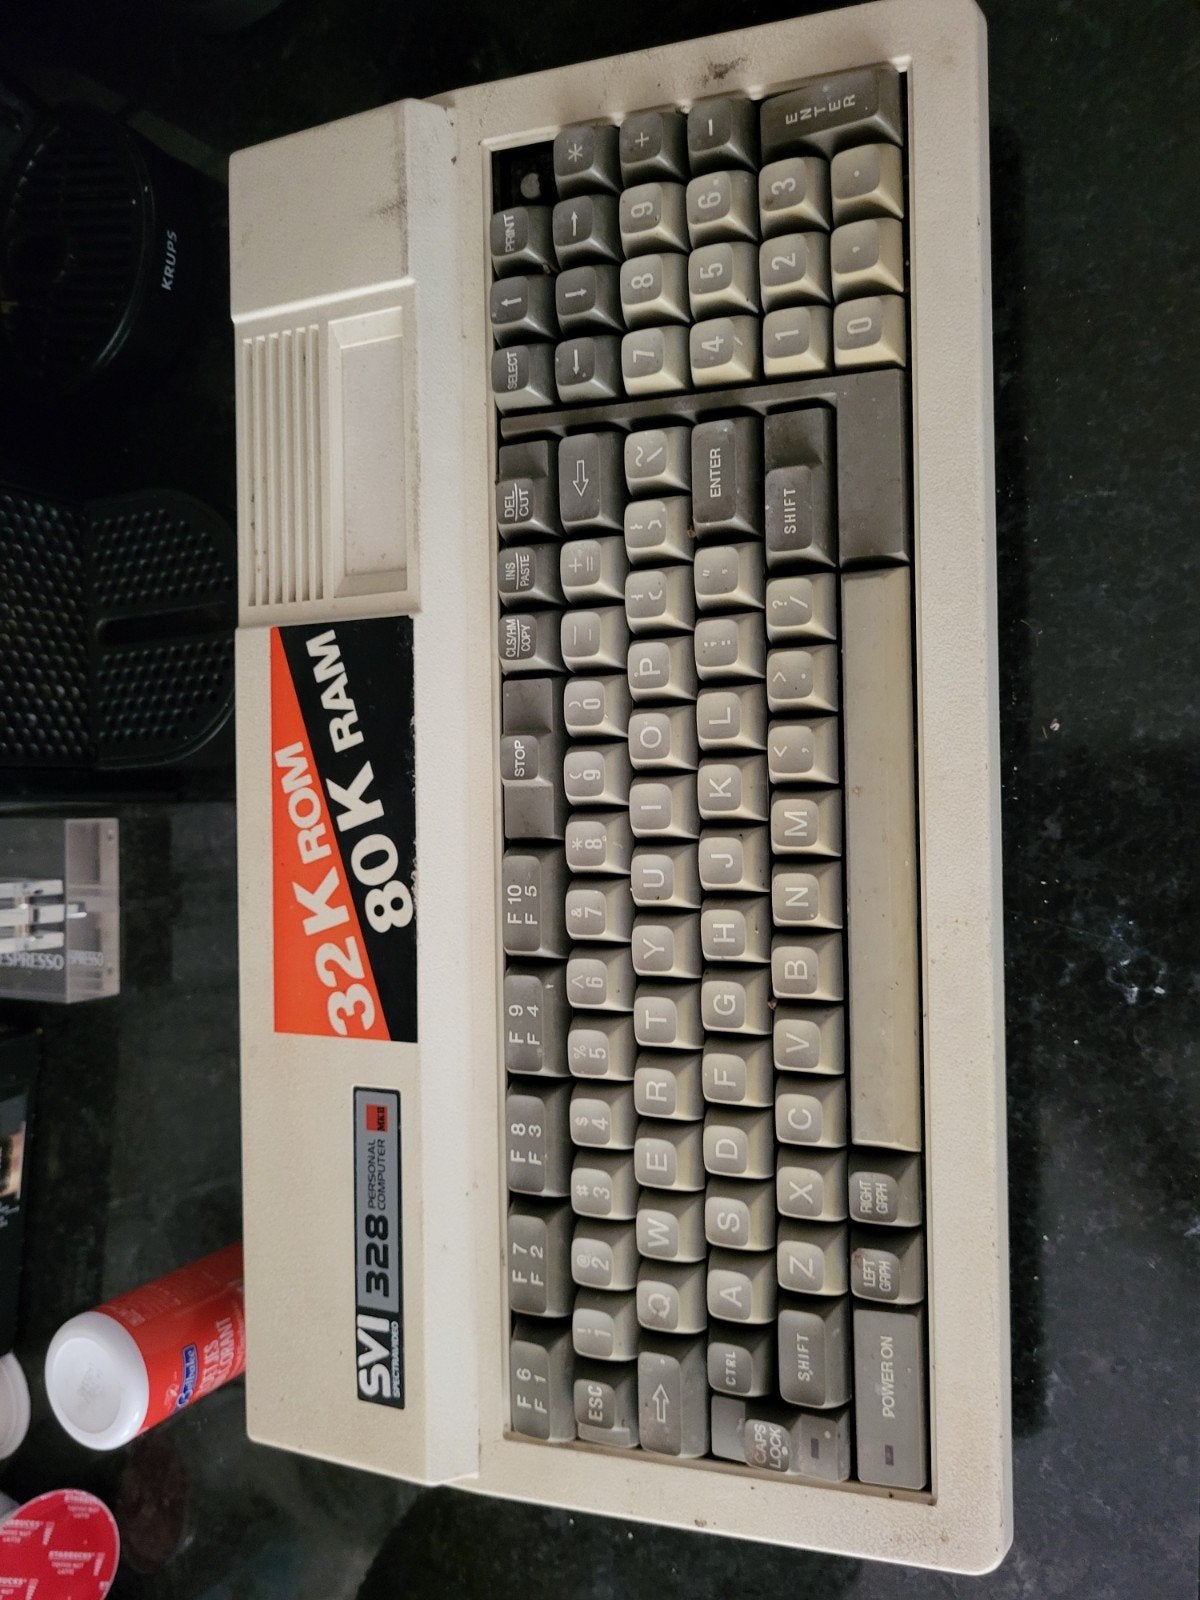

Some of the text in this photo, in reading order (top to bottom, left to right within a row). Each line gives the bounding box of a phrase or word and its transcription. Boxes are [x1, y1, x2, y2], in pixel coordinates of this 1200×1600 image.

[786, 95, 855, 124] ENTER
[635, 132, 649, 147] +
[771, 178, 796, 195] 3
[631, 201, 653, 217] 9
[698, 192, 721, 209] 6
[503, 214, 515, 252] PRINT
[161, 230, 178, 291] KRUPS
[771, 253, 795, 270] 2
[631, 273, 653, 289] 8
[700, 263, 722, 279] 5
[775, 330, 799, 341] 1
[847, 317, 872, 334] 0
[702, 336, 724, 352] 4
[633, 350, 654, 363] 7
[507, 350, 518, 389] SELECT
[710, 448, 722, 498] ENTER
[505, 491, 515, 517] DEL
[519, 490, 529, 516] CUT
[784, 489, 796, 534] SHIFT
[505, 562, 516, 580] INS
[519, 555, 530, 586] PASTE
[569, 557, 583, 573] +
[587, 556, 593, 571] =
[772, 600, 787, 609] ?
[790, 596, 808, 608] /
[505, 619, 518, 657] CLS/HM
[520, 625, 531, 651] COPY
[640, 658, 660, 675] P
[773, 672, 786, 682] >
[306, 629, 364, 753] RAM
[583, 698, 600, 709] 0
[709, 707, 730, 724] L
[640, 726, 661, 748] O
[514, 740, 525, 776] STOP
[774, 746, 787, 757] <
[583, 770, 600, 780] 9
[709, 777, 731, 797] K
[275, 742, 331, 864] ROM
[784, 812, 807, 836] M
[585, 839, 602, 849] 8
[711, 854, 733, 868] J
[643, 869, 664, 887] U
[507, 885, 522, 924] F 10
[525, 886, 537, 924] F 5
[785, 887, 808, 906] N
[571, 908, 582, 917] &
[585, 907, 602, 918] 7
[713, 924, 735, 942] H
[643, 938, 664, 959] Y
[785, 960, 808, 980] B
[586, 977, 603, 988] 6
[713, 995, 735, 1015] G
[509, 1005, 524, 1044] F 9
[527, 1005, 540, 1045] F 4
[646, 1010, 666, 1029] T
[573, 1045, 586, 1059] %
[786, 1032, 809, 1053] V
[589, 1048, 606, 1059] 5
[714, 1068, 736, 1086] F
[646, 1081, 667, 1102] R
[574, 1117, 588, 1126] $
[592, 1118, 608, 1131] 4
[788, 1108, 812, 1129] C
[511, 1123, 526, 1162] F 8
[529, 1125, 541, 1165] F 3
[716, 1139, 738, 1159] D
[646, 1152, 667, 1171] E
[368, 1140, 376, 1209] PERSONAL
[377, 1139, 386, 1211] COMPUTER
[576, 1185, 589, 1196] #
[593, 1187, 610, 1199] 3
[789, 1181, 813, 1204] X
[859, 1180, 872, 1213] RIGHT
[875, 1183, 888, 1214] GRPH
[647, 1217, 669, 1247] W
[717, 1213, 740, 1232] S
[366, 1214, 389, 1297] 328
[512, 1242, 527, 1283] F 7
[530, 1245, 544, 1286] F 2
[577, 1254, 591, 1268] @
[592, 1258, 609, 1271] 2
[790, 1256, 814, 1276] Z
[863, 1258, 876, 1287] LEFT
[879, 1260, 891, 1292] GRPH
[720, 1286, 742, 1307] A
[595, 1329, 611, 1337] 1
[357, 1314, 391, 1398] SVI
[391, 1321, 400, 1398] SPECTRAVIDEO
[797, 1333, 812, 1381] SHIFT
[725, 1351, 736, 1386] CTRL
[881, 1336, 895, 1418] POWER ON
[517, 1368, 531, 1408] F 6
[534, 1398, 547, 1413] F
[588, 1384, 603, 1421] ESC
[752, 1423, 767, 1464] CAPS
[768, 1425, 783, 1469] LOCK
